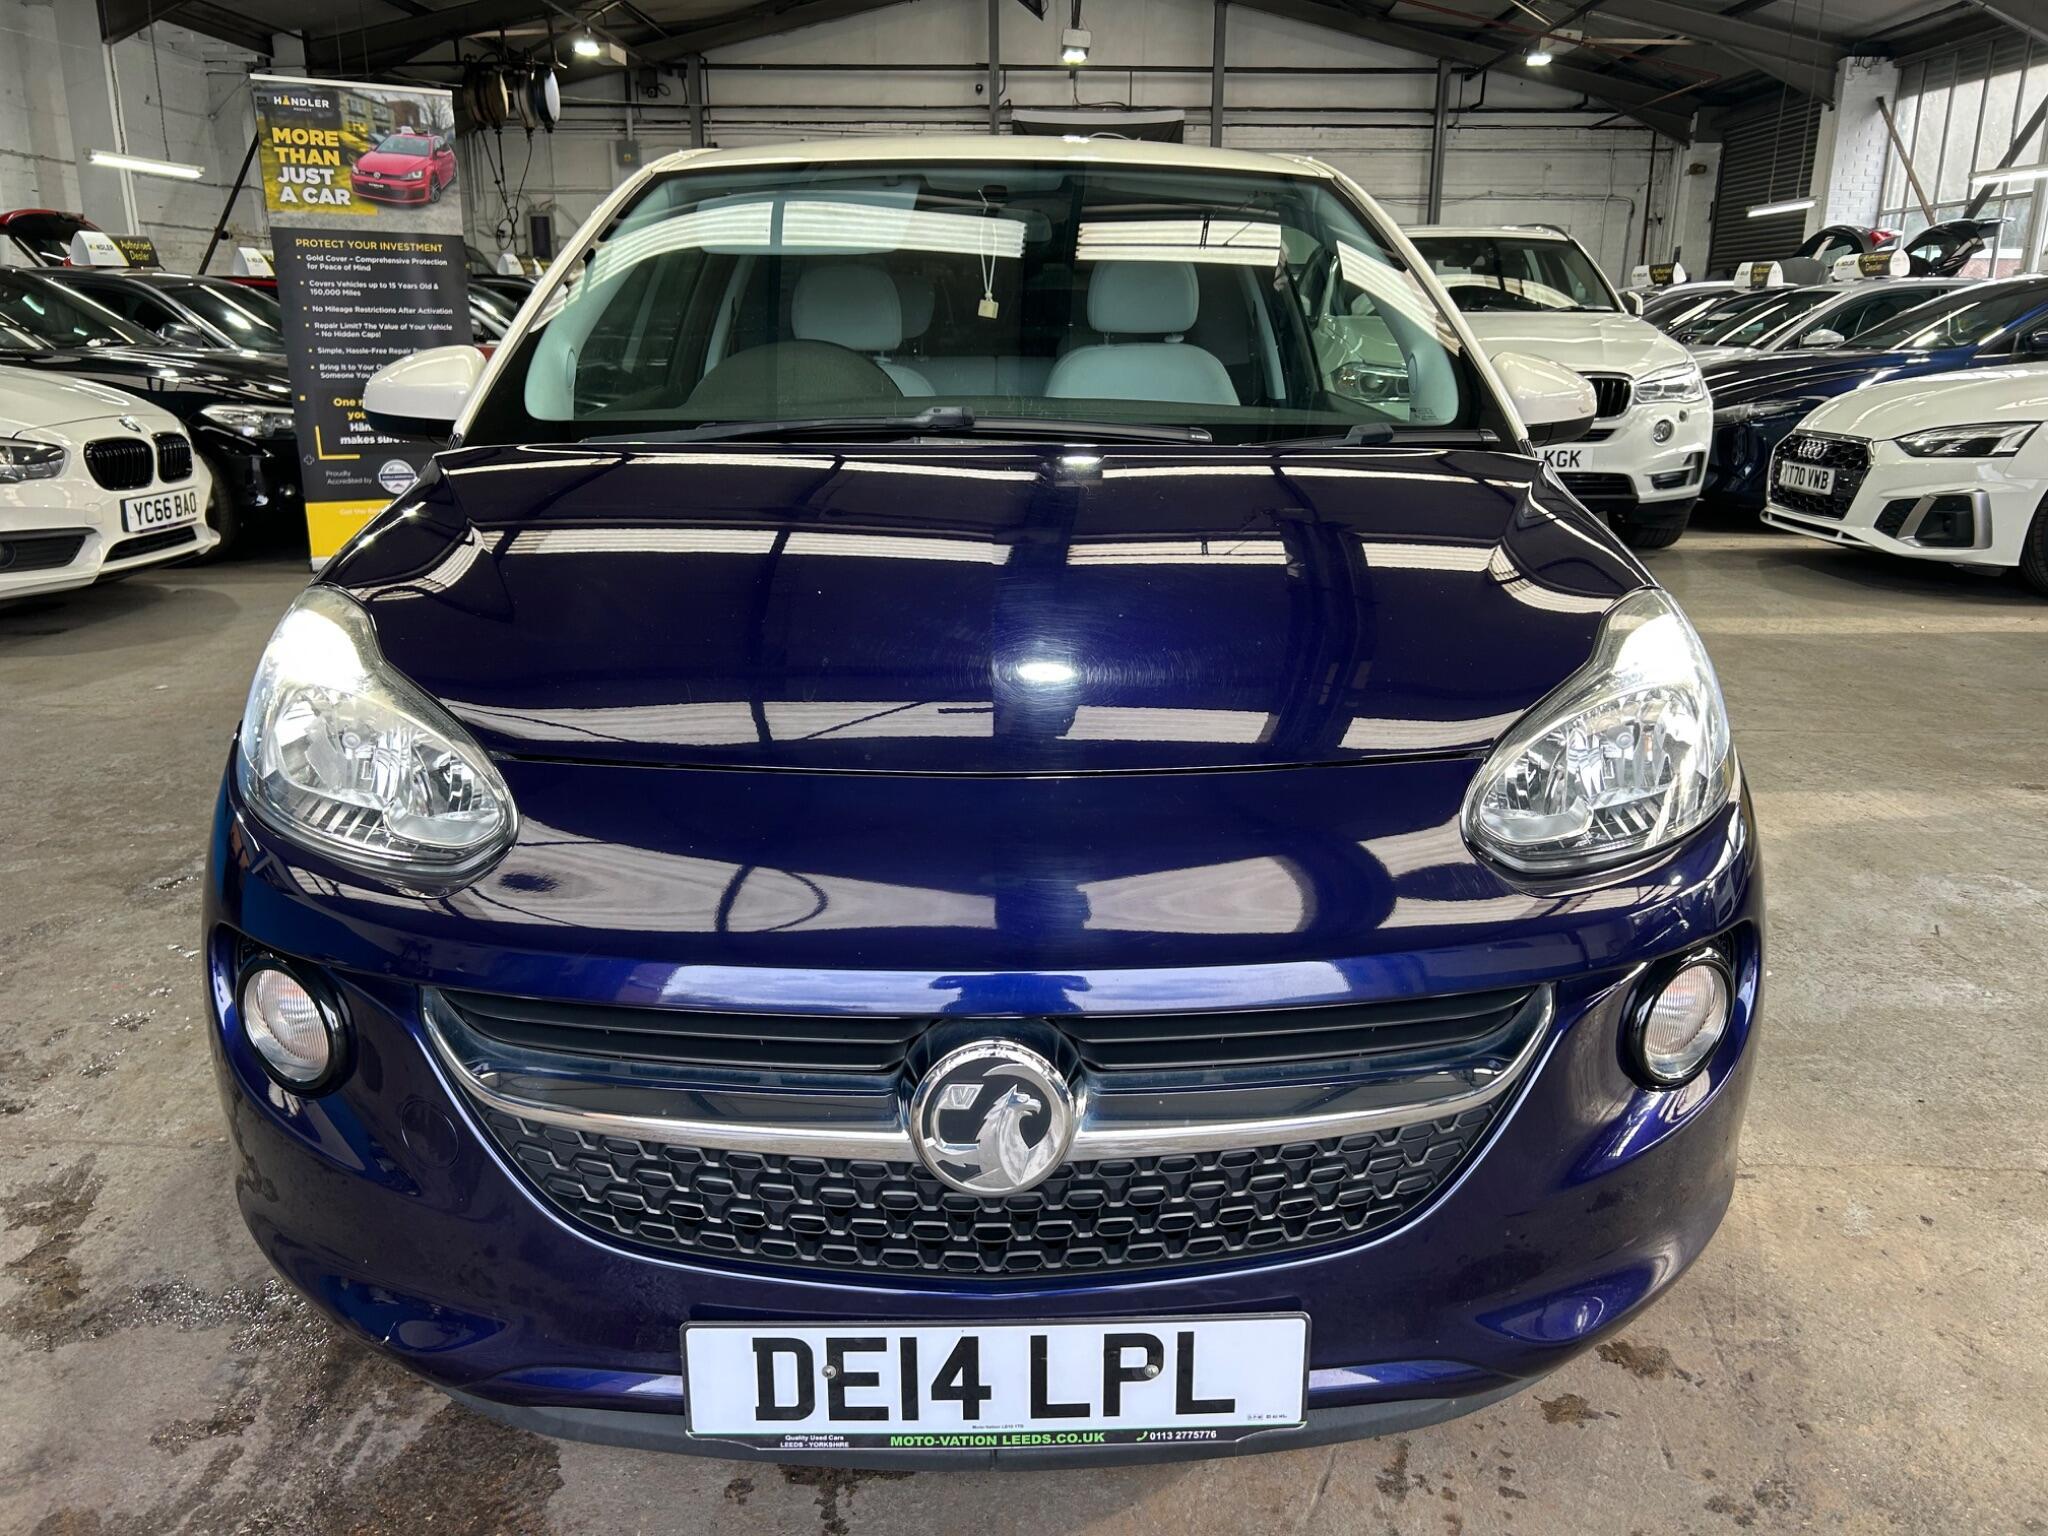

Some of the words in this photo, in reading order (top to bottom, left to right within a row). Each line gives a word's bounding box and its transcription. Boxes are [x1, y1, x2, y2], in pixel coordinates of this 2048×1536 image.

[271, 127, 339, 147] MORE
[273, 147, 340, 166] THAN
[277, 166, 335, 185] JUST
[280, 186, 298, 203] A
[302, 186, 351, 206] CAR
[295, 239, 345, 249] PROTECT
[347, 240, 378, 250] YOUR
[380, 241, 443, 253] INVESTMENT
[305, 254, 324, 262] Gold
[355, 256, 410, 264] Comprehensive
[411, 257, 448, 266] Protection
[320, 263, 342, 271] Peace
[353, 264, 372, 272] Mind
[336, 280, 367, 288] Vehicles
[368, 282, 379, 290] up
[397, 282, 418, 290] Years
[333, 398, 356, 407] One
[340, 435, 376, 445] makes
[1544, 449, 1583, 468] KGK
[133, 498, 172, 526] YC66
[752, 1336, 992, 1421] DE14
[1030, 1331, 1235, 1419] LPL
[890, 1434, 998, 1447] MOTO-VATION
[1002, 1432, 1105, 1446] LEEDS.CO.UK
[1149, 1432, 1174, 1440] 0113
[1175, 1430, 1217, 1440] 2775776
